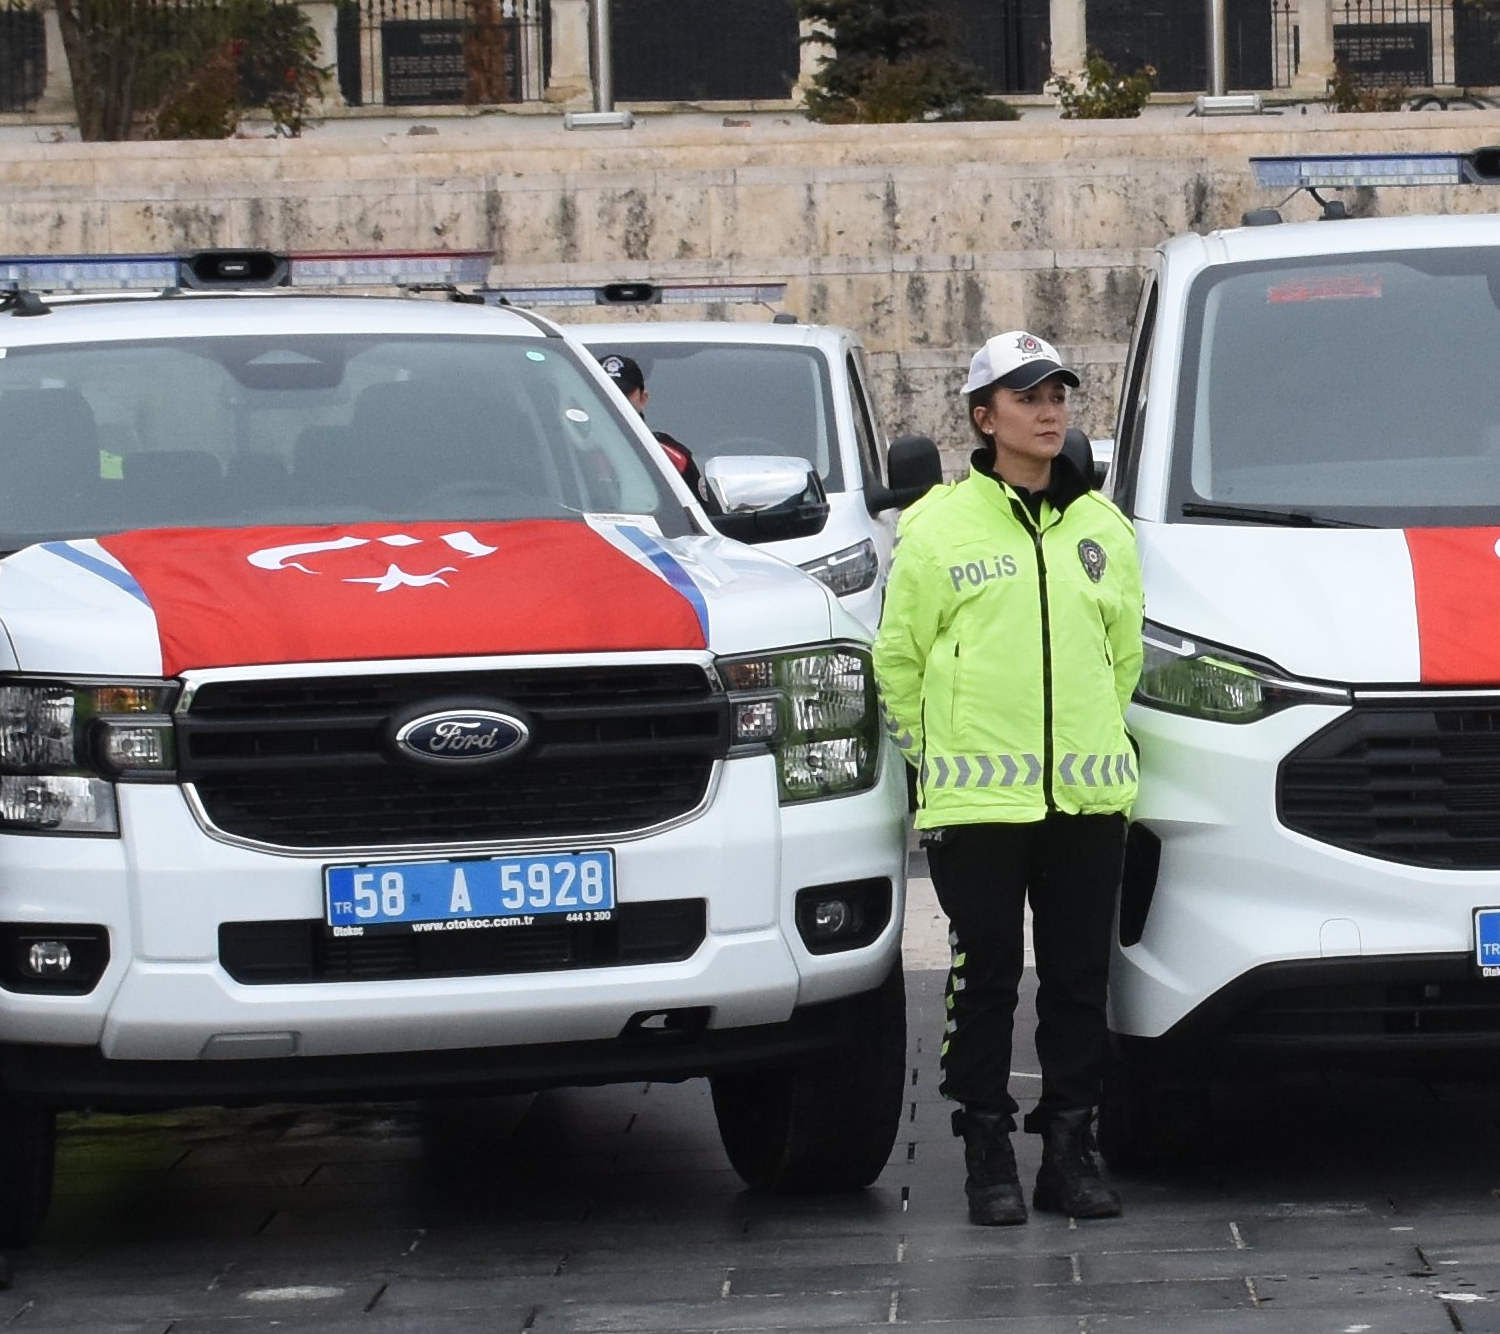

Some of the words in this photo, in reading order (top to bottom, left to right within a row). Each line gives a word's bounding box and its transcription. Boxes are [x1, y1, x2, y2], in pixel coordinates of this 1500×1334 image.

[429, 721, 499, 752] Ford
[353, 872, 405, 918] 58
[449, 867, 472, 913] A
[500, 860, 604, 909] 5928
[334, 901, 352, 914] TR
[412, 914, 535, 934] www.otokoc.com.tr
[565, 912, 583, 922] 444
[585, 911, 592, 922] 3
[1482, 943, 1500, 956] TR
